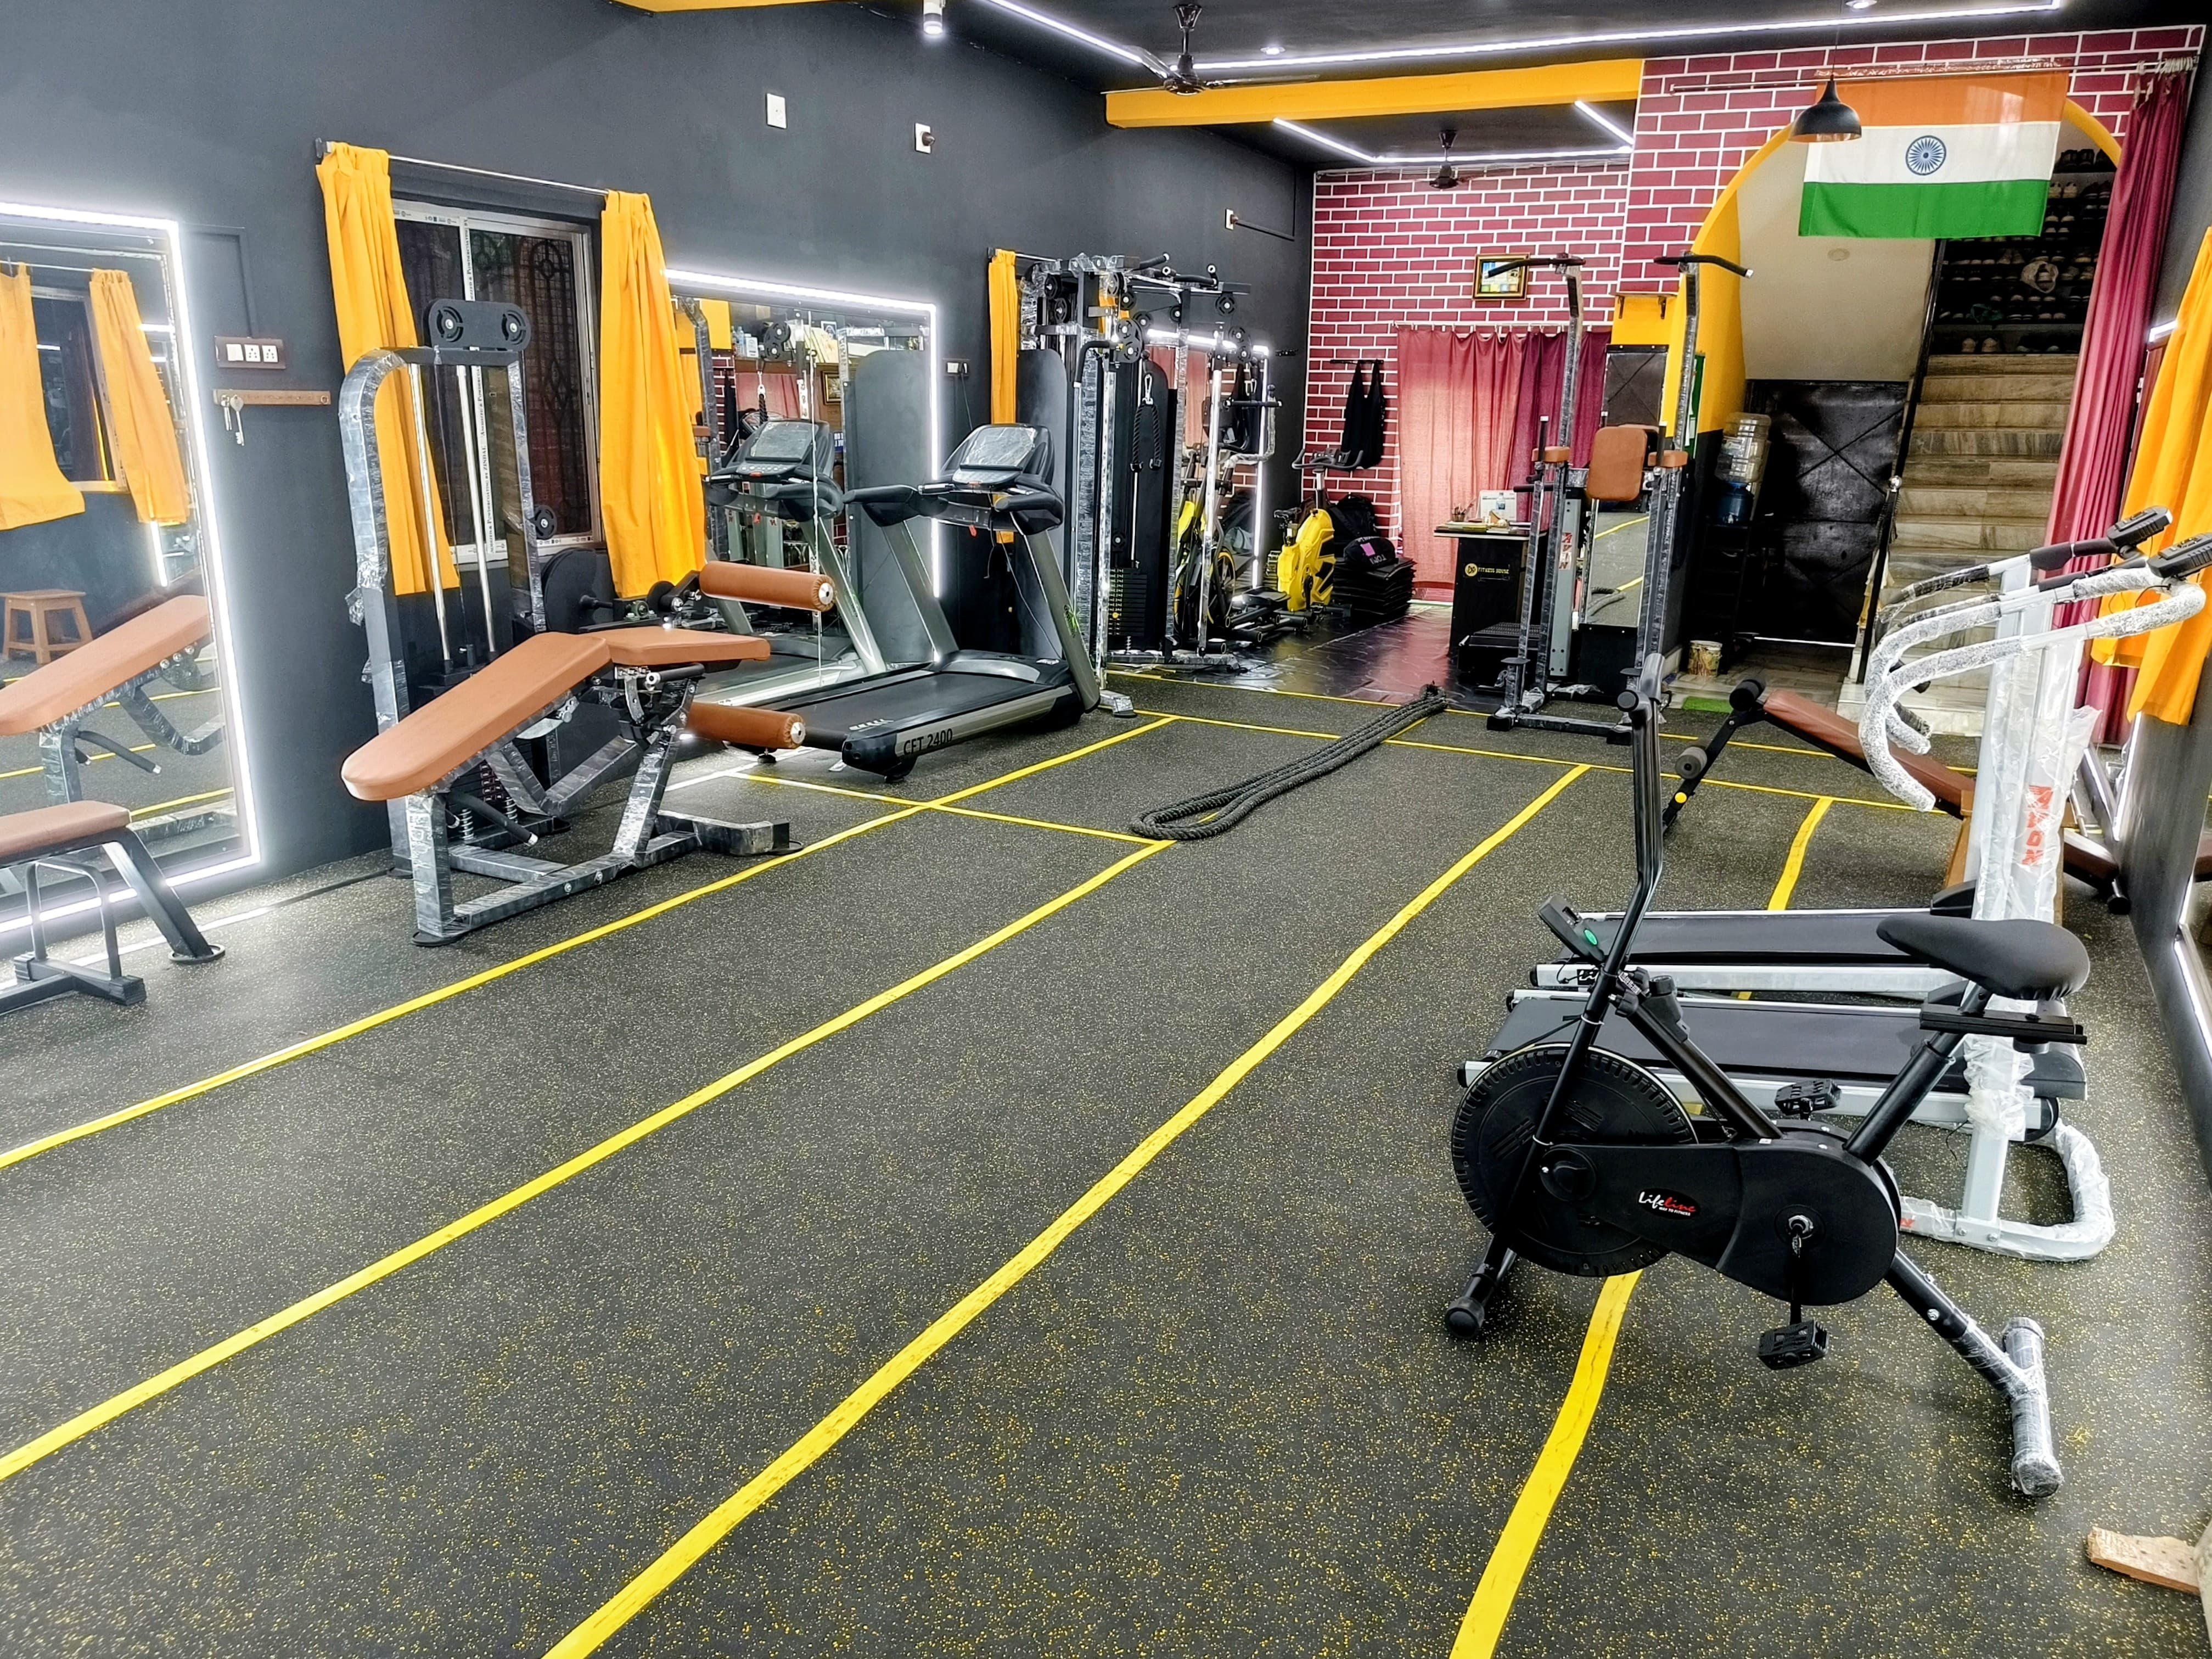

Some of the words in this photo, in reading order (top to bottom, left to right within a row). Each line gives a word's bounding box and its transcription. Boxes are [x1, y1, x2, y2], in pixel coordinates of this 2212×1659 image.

[903, 737, 924, 755] CFT
[927, 728, 952, 748] 2400
[1638, 1191, 1696, 1212] Lifeline
